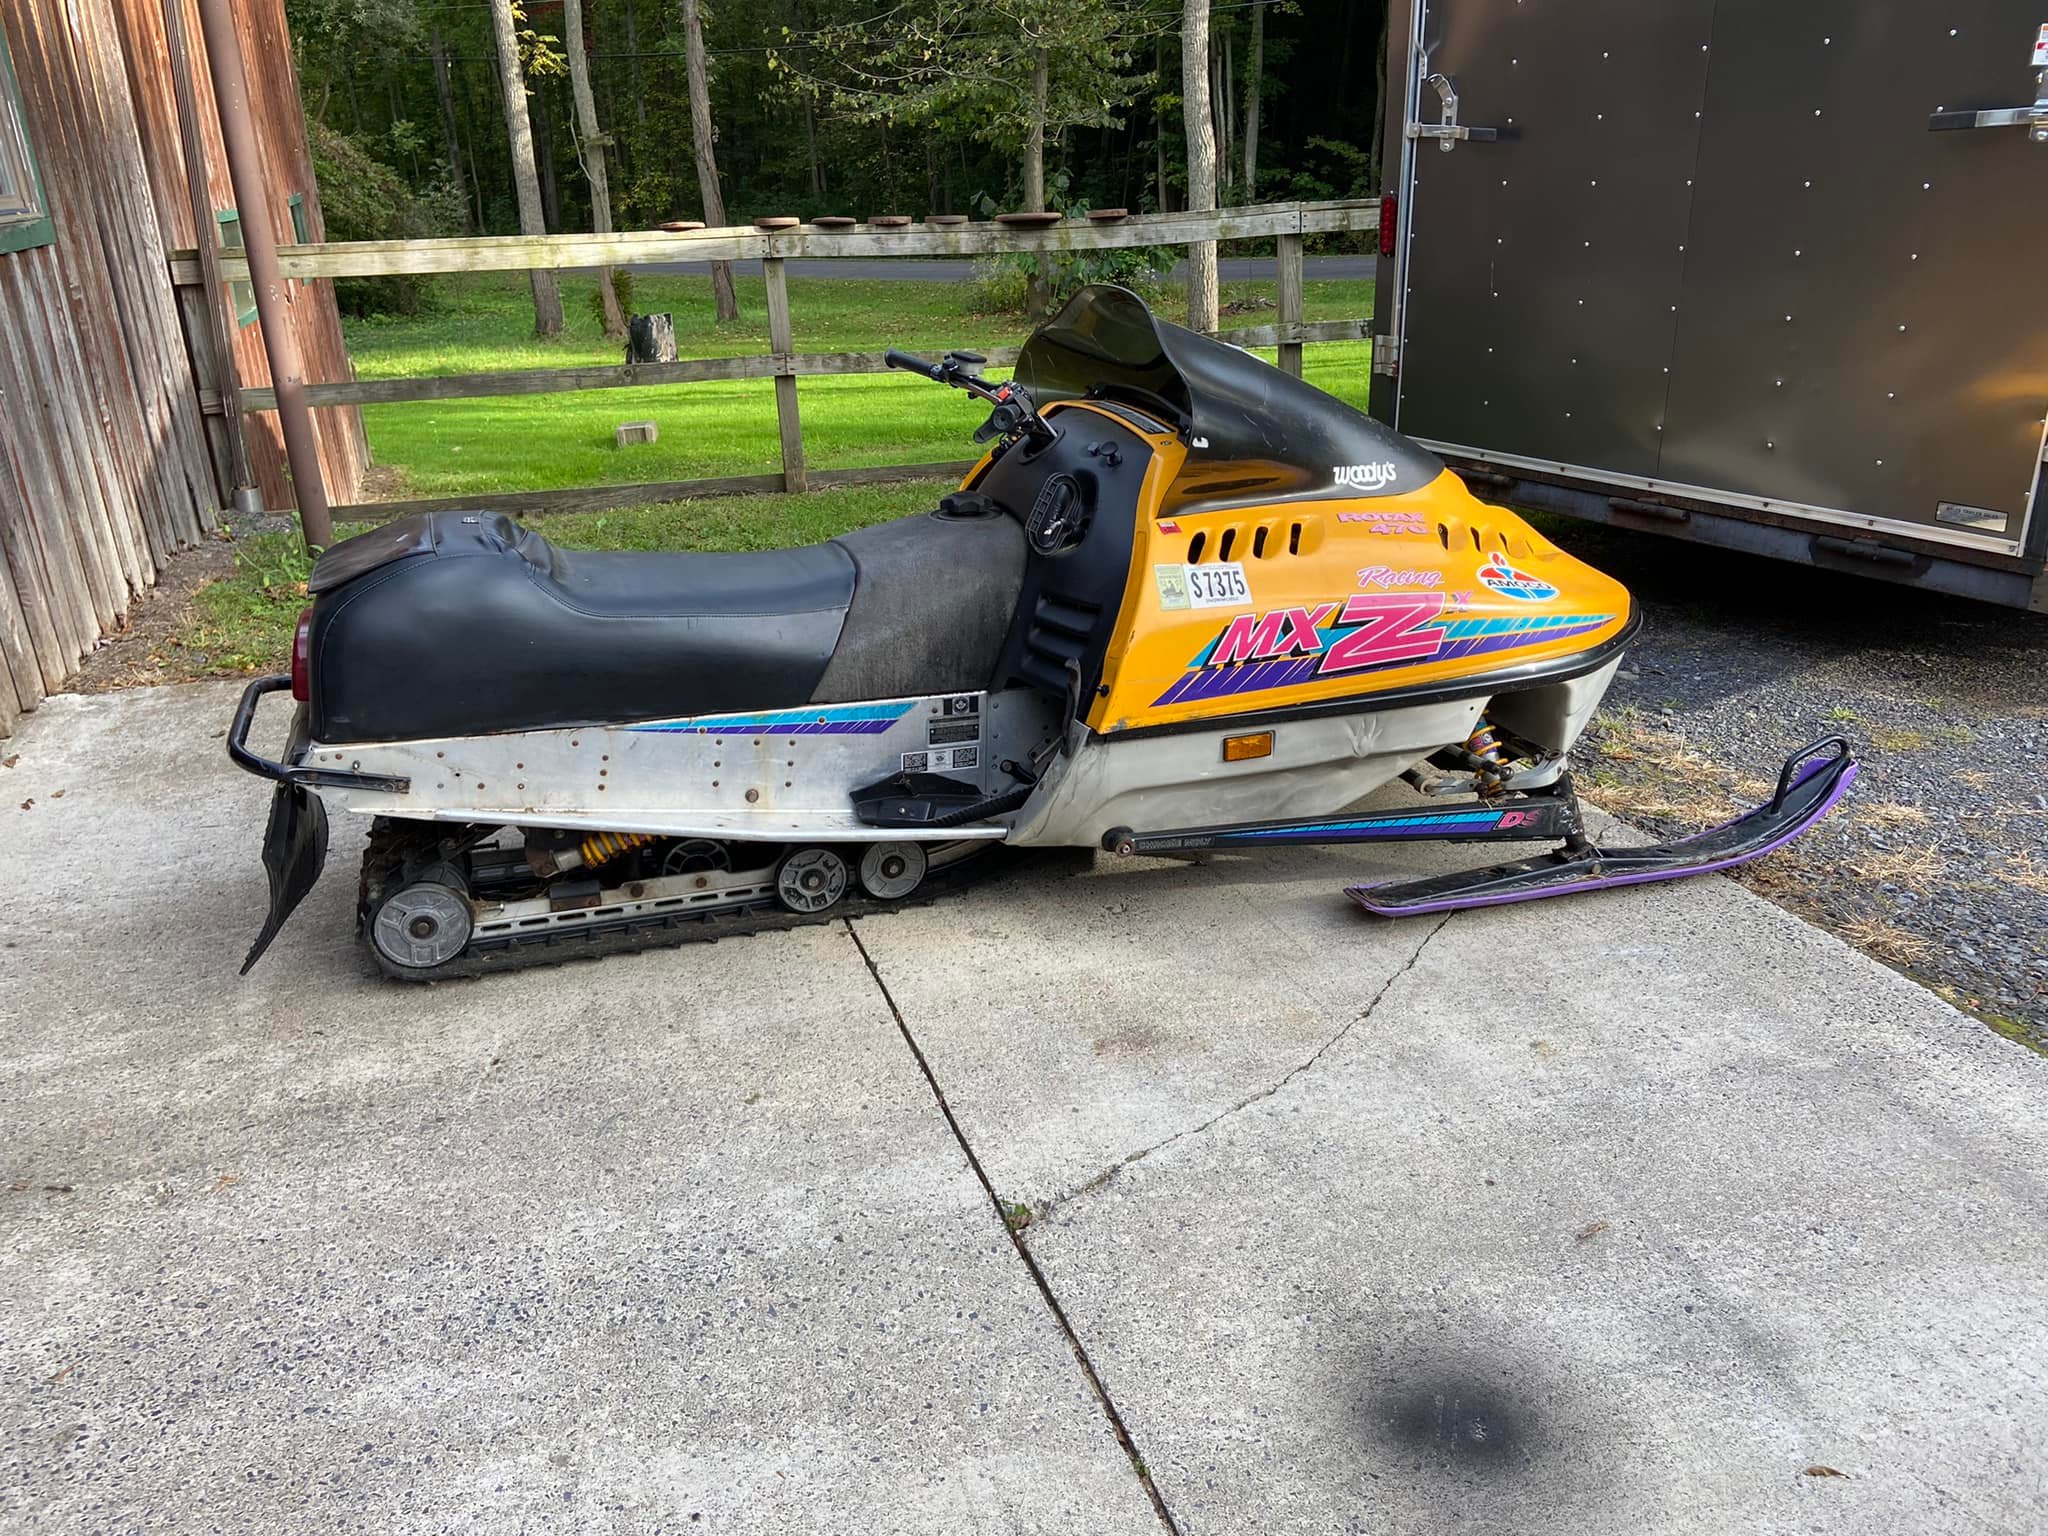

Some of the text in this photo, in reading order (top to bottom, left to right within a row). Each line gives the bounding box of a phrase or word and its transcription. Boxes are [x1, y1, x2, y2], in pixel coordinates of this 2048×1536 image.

[1336, 511, 1425, 523] ROTAX
[1357, 565, 1444, 589] Racing
[1486, 578, 1552, 590] AMOCO
